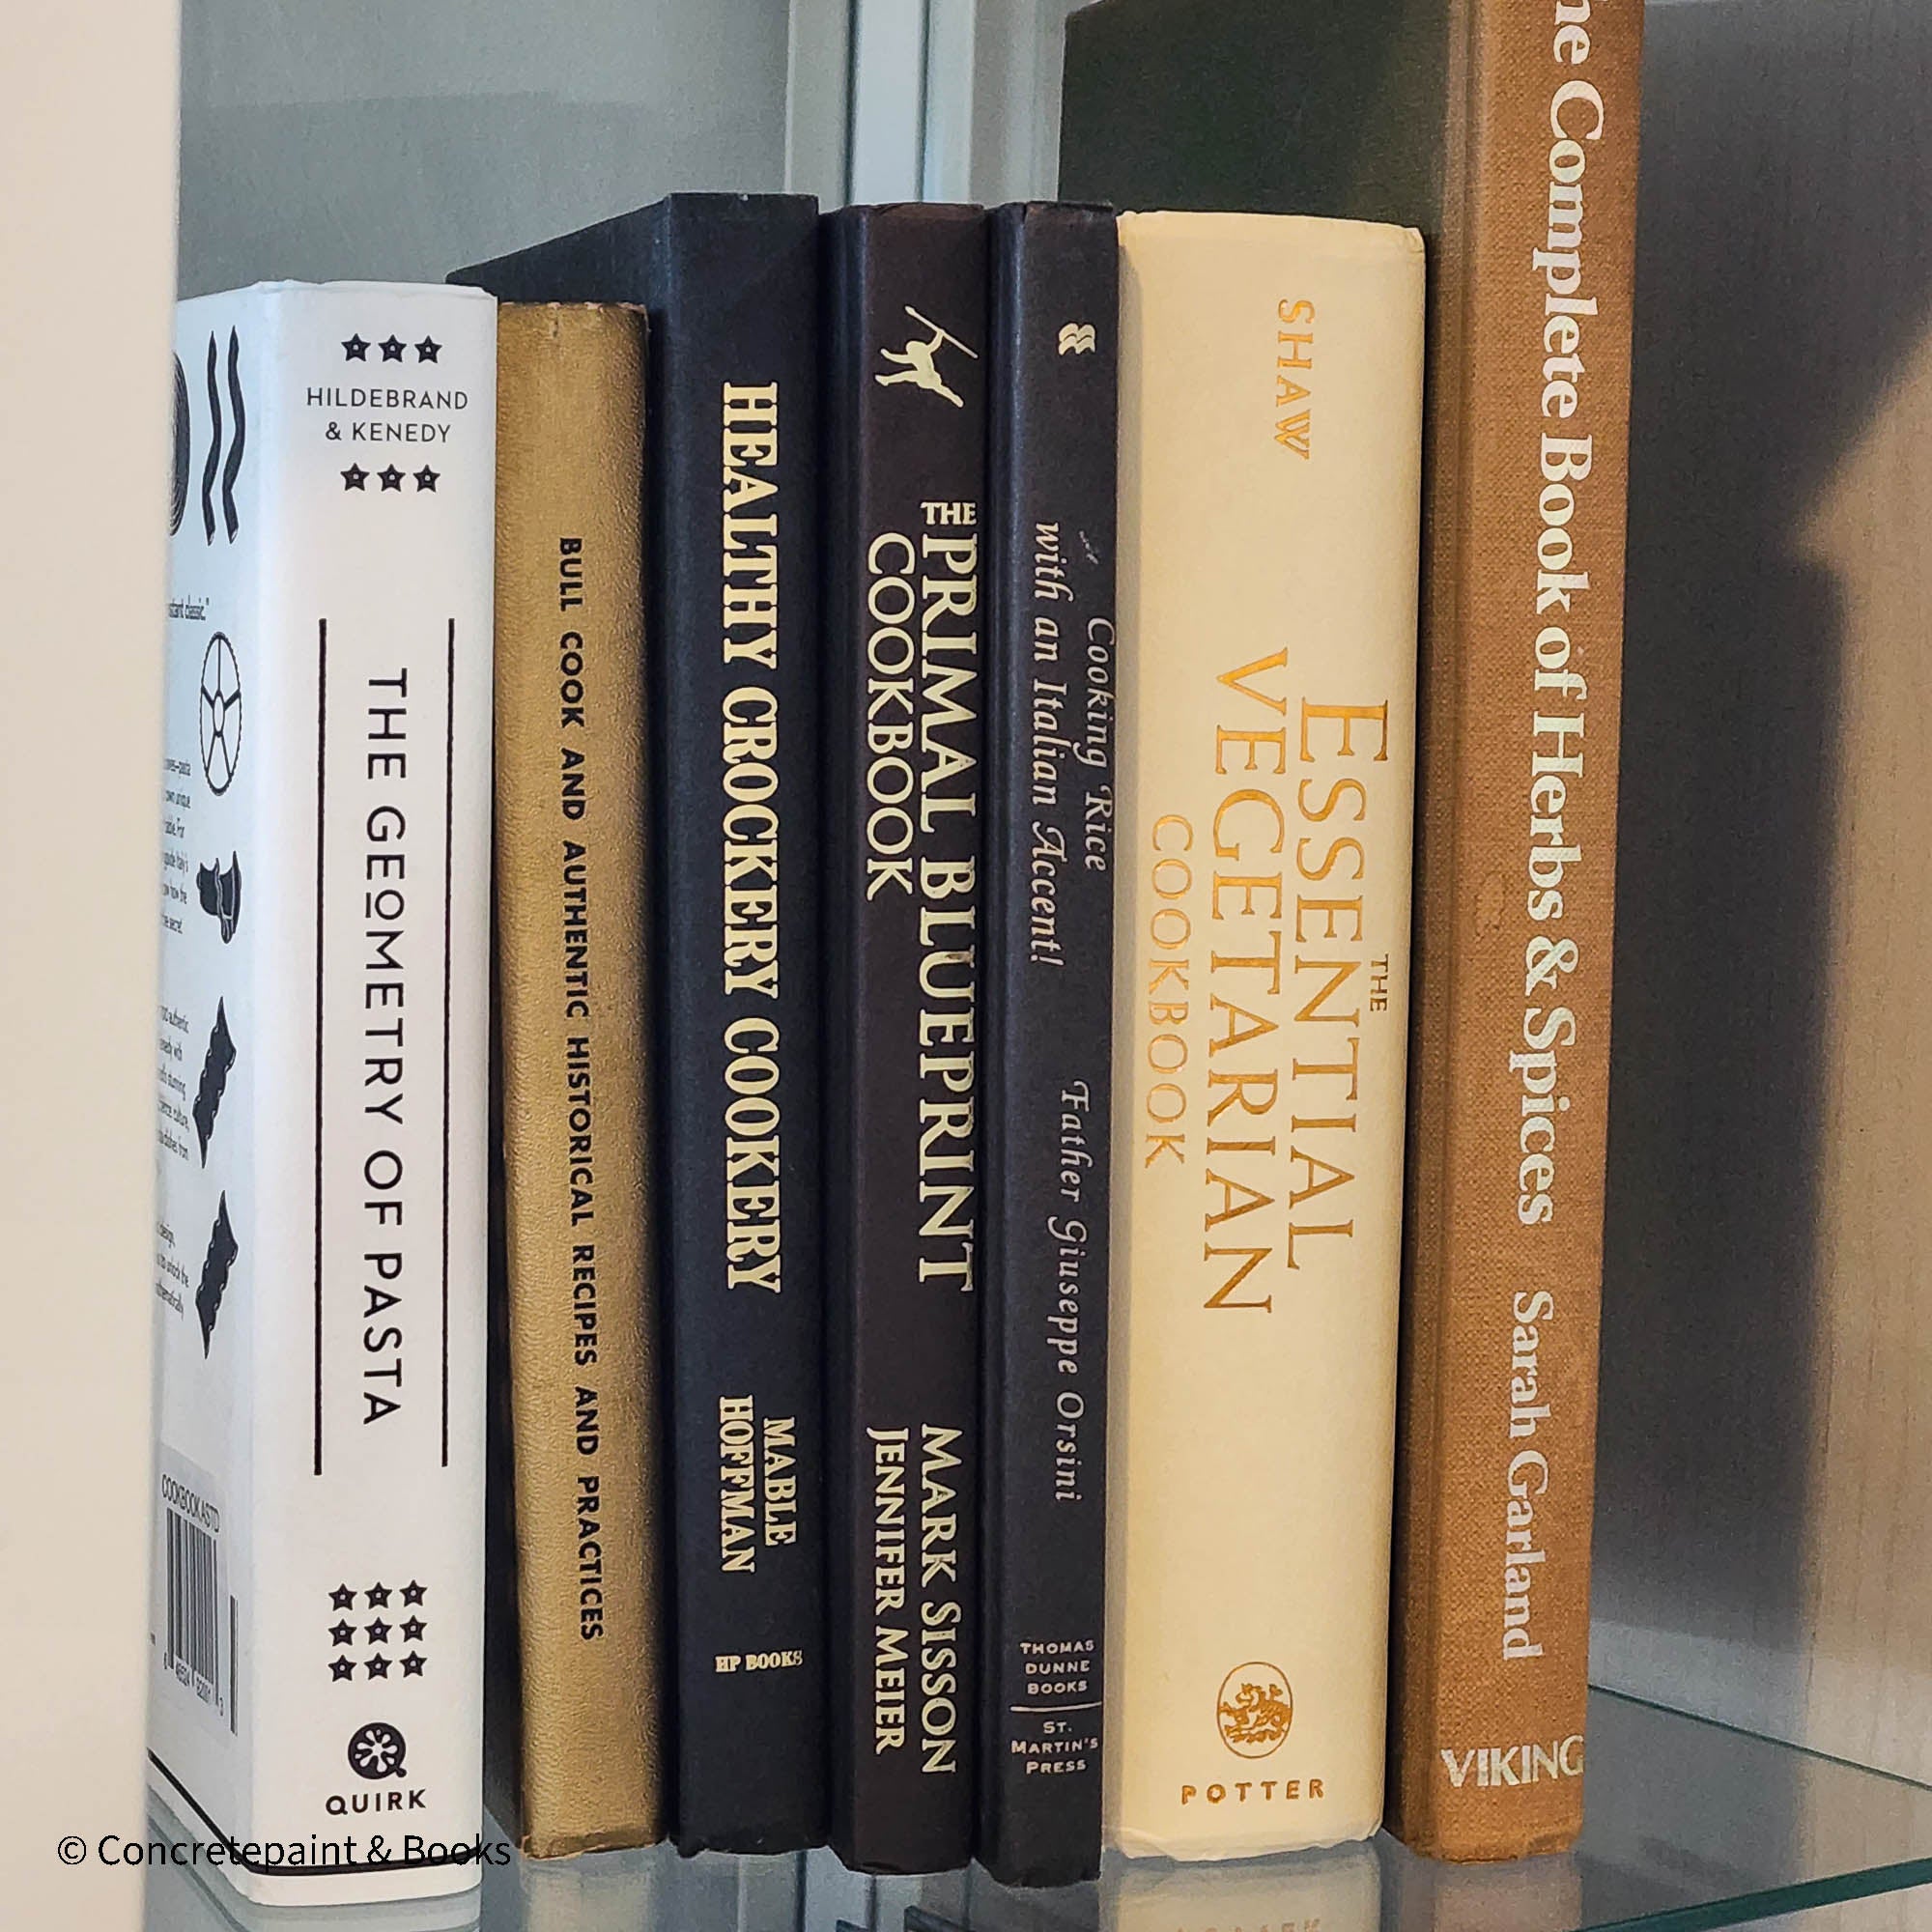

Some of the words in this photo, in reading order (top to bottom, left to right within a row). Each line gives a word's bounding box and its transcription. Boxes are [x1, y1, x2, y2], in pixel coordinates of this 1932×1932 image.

[1553, 0, 1608, 65] he
[1533, 79, 1604, 417] Complete
[307, 387, 468, 410] HILDEBRAND
[326, 422, 341, 440] &
[353, 422, 450, 442] KENEDY
[1274, 299, 1315, 460] SHAW
[560, 538, 582, 611] BULL
[724, 383, 778, 668] HEALTHY
[921, 502, 976, 525] THE
[1036, 524, 1073, 601] with
[1537, 433, 1592, 613] Book
[560, 632, 583, 727] COOK
[921, 534, 977, 832] PRIMAL
[1035, 617, 1058, 661] an
[1073, 618, 1114, 767] Cooking
[1535, 628, 1587, 699] of
[368, 668, 407, 779] THE
[867, 533, 915, 900] COOKBOOK
[1033, 679, 1072, 806] Italian
[560, 749, 585, 820] AND
[724, 687, 778, 998] CROCKERY
[1085, 785, 1112, 870] Rice
[1528, 711, 1584, 920] Herbs
[563, 840, 588, 1017] AUTHENTIC
[1031, 820, 1067, 965] Accent!
[365, 807, 405, 1124] GEOMETRY
[1145, 814, 1193, 1168] COOKBOOK
[1204, 647, 1288, 1313] VEGETARIAN
[1286, 697, 1391, 1269] ESSENTIAL
[1371, 954, 1388, 1011] THE
[1525, 937, 1577, 996] &
[567, 1037, 593, 1226] HISTORICAL
[920, 857, 975, 1291] BLUEPRINT
[1509, 1008, 1576, 1224] Spices
[364, 1151, 402, 1225] OF
[724, 1018, 781, 1293] COOKERY
[1061, 1081, 1093, 1202] Father
[364, 1253, 402, 1424] PASTA
[573, 1245, 597, 1365] RECIPES
[1047, 1217, 1086, 1373] Giuseppe
[576, 1387, 599, 1455] AND
[1510, 1292, 1553, 1438] Sarah
[720, 1395, 754, 1572] HOFFMAN
[764, 1417, 796, 1546] MABLE
[922, 1424, 962, 1587] MARK
[1056, 1393, 1083, 1499] Orsini
[578, 1476, 603, 1639] PRACTICES
[867, 1428, 908, 1615] JENNIFER
[1503, 1451, 1548, 1661] Garland
[716, 1655, 741, 1672] HP
[745, 1650, 803, 1671] BOOKS
[876, 1626, 908, 1754] MEIER
[922, 1603, 961, 1772] SISSON
[1020, 1640, 1094, 1655] THOMAS
[1025, 1660, 1091, 1675] DUNNE
[1027, 1680, 1088, 1695] BOOKS
[1010, 1738, 1098, 1754] MARTIN'S
[1026, 1759, 1087, 1775] PRESS
[1043, 1720, 1072, 1734] ST.
[1440, 1735, 1584, 1787] VIKING
[326, 1789, 425, 1815] QUIRK
[1180, 1778, 1324, 1805] POTTER
